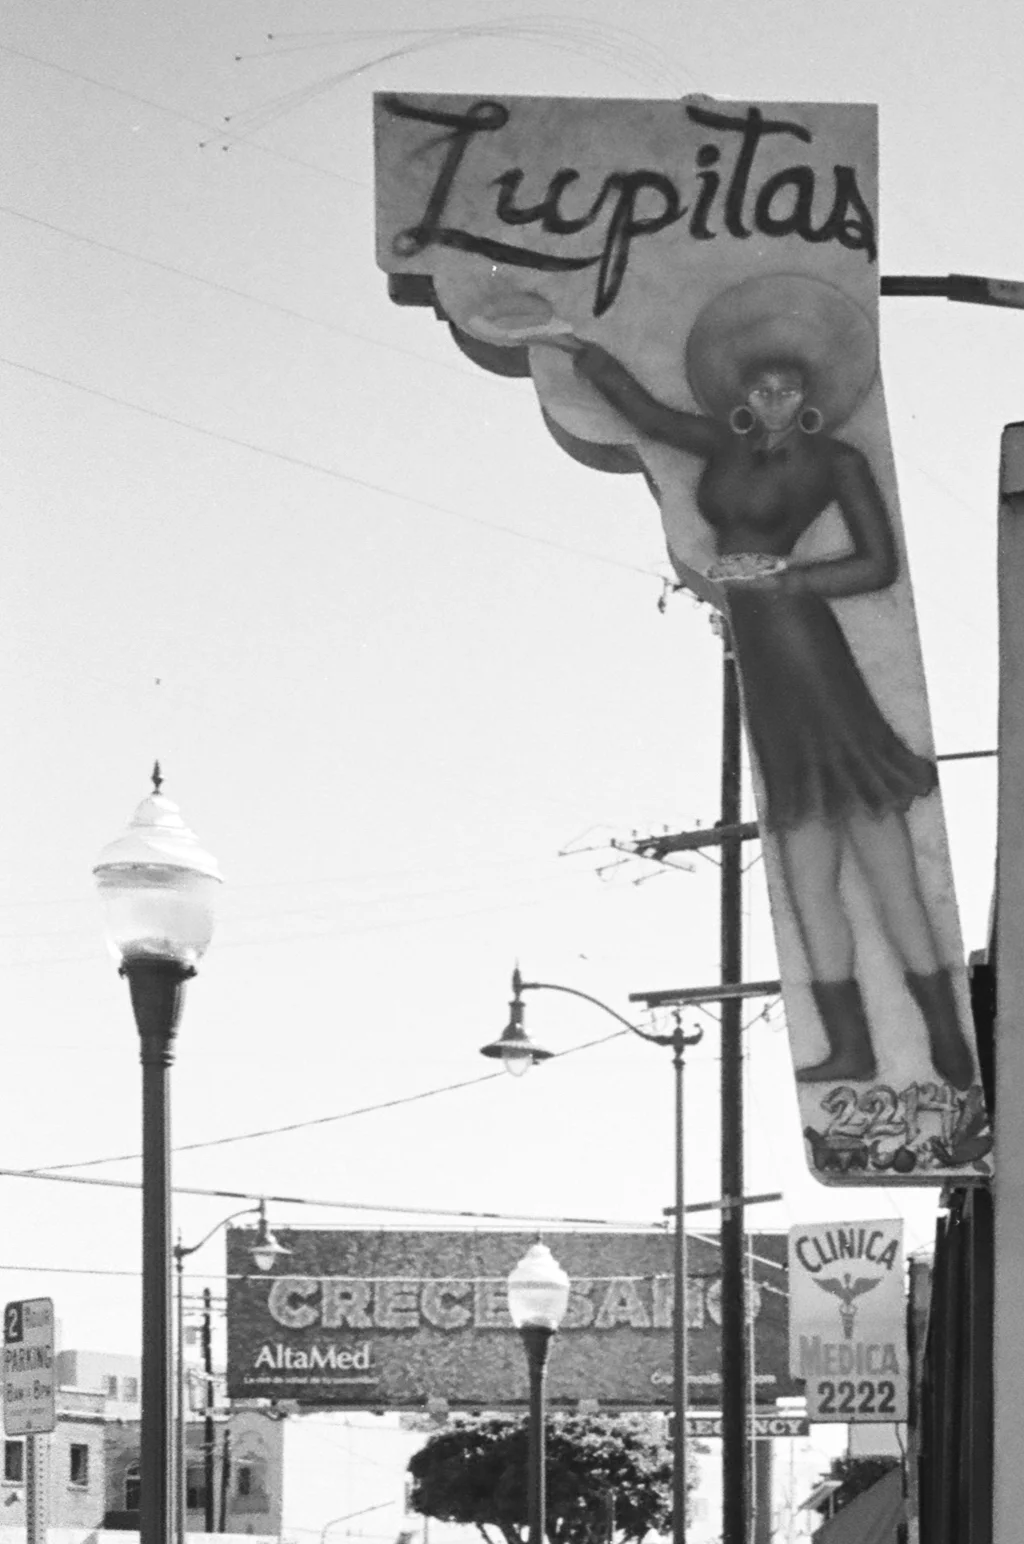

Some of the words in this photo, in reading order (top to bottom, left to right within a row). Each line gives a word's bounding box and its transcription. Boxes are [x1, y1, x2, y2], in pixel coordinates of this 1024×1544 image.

[795, 1228, 899, 1273] CLINICA
[7, 1307, 19, 1338] 2
[254, 1343, 371, 1369] AltaMed
[800, 1335, 900, 1376] MEDICA
[817, 1380, 896, 1414] 2222
